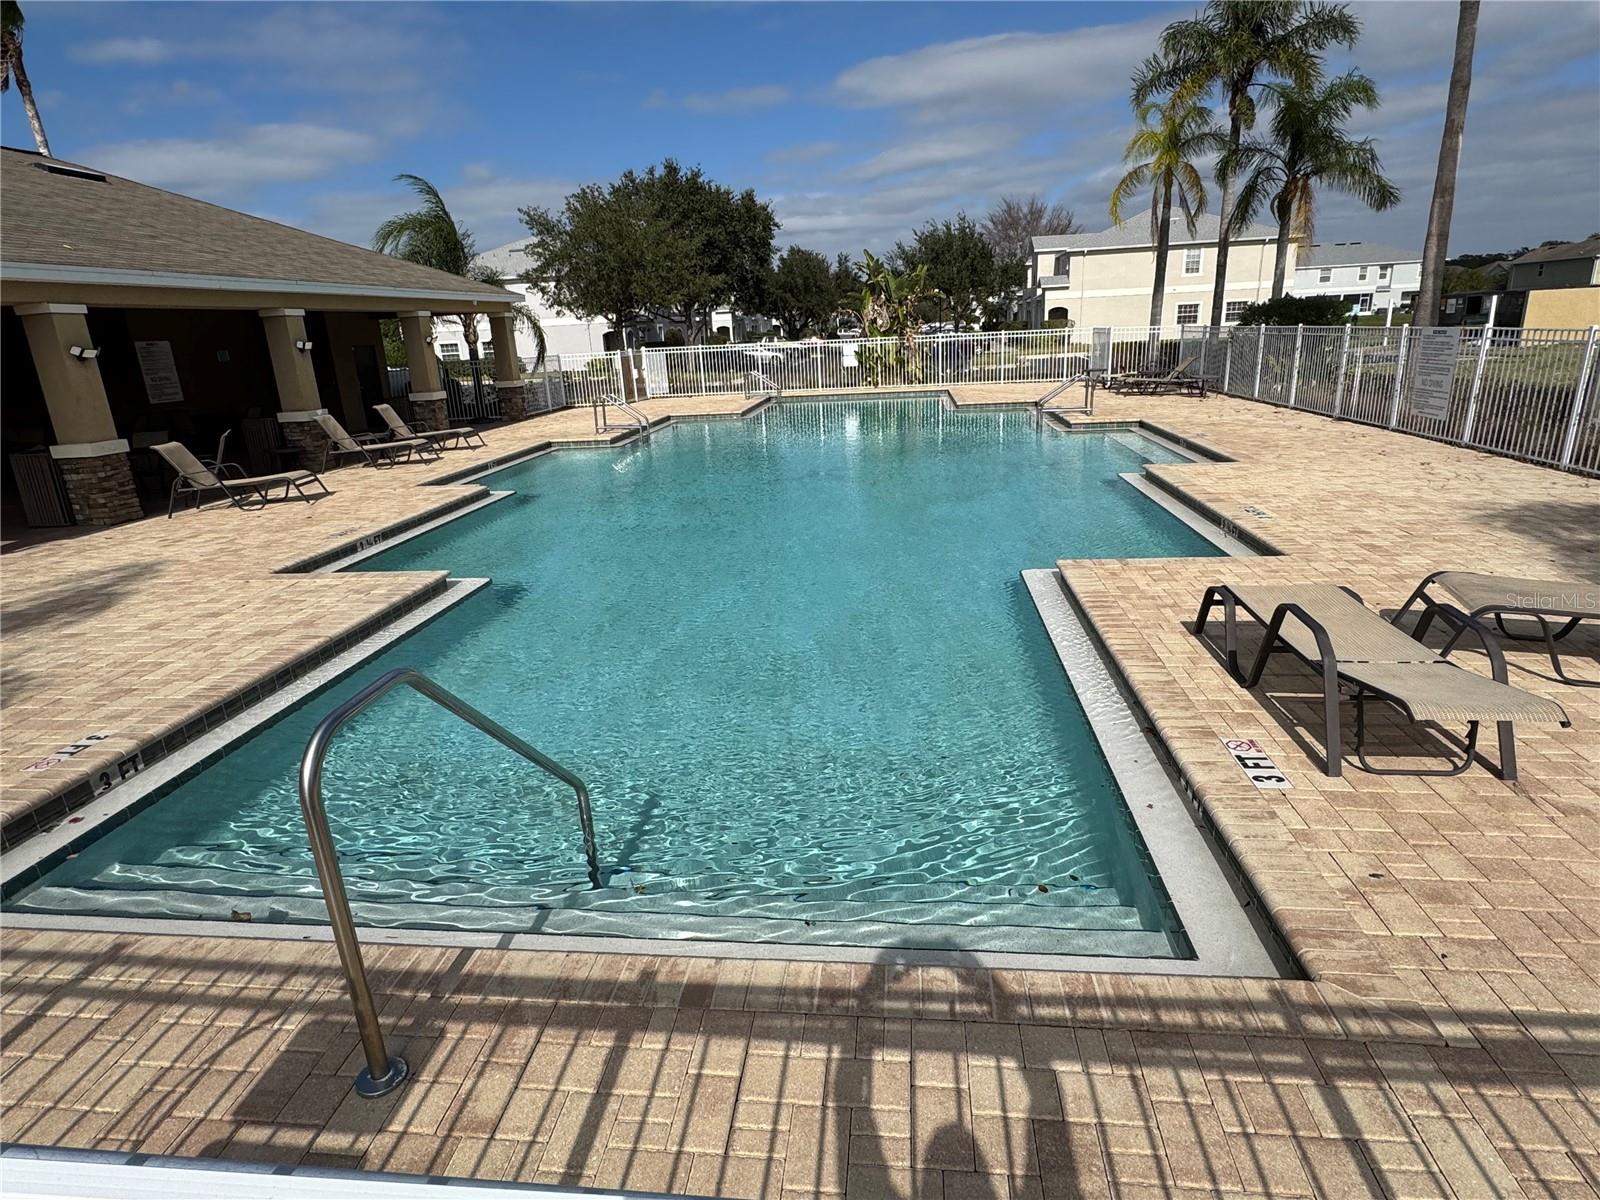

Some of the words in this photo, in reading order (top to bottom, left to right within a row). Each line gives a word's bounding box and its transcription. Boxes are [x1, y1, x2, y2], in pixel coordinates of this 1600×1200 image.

[1234, 754, 1276, 769] FT
[99, 772, 112, 791] 3
[117, 752, 139, 780] FT
[1252, 775, 1286, 783] 3
